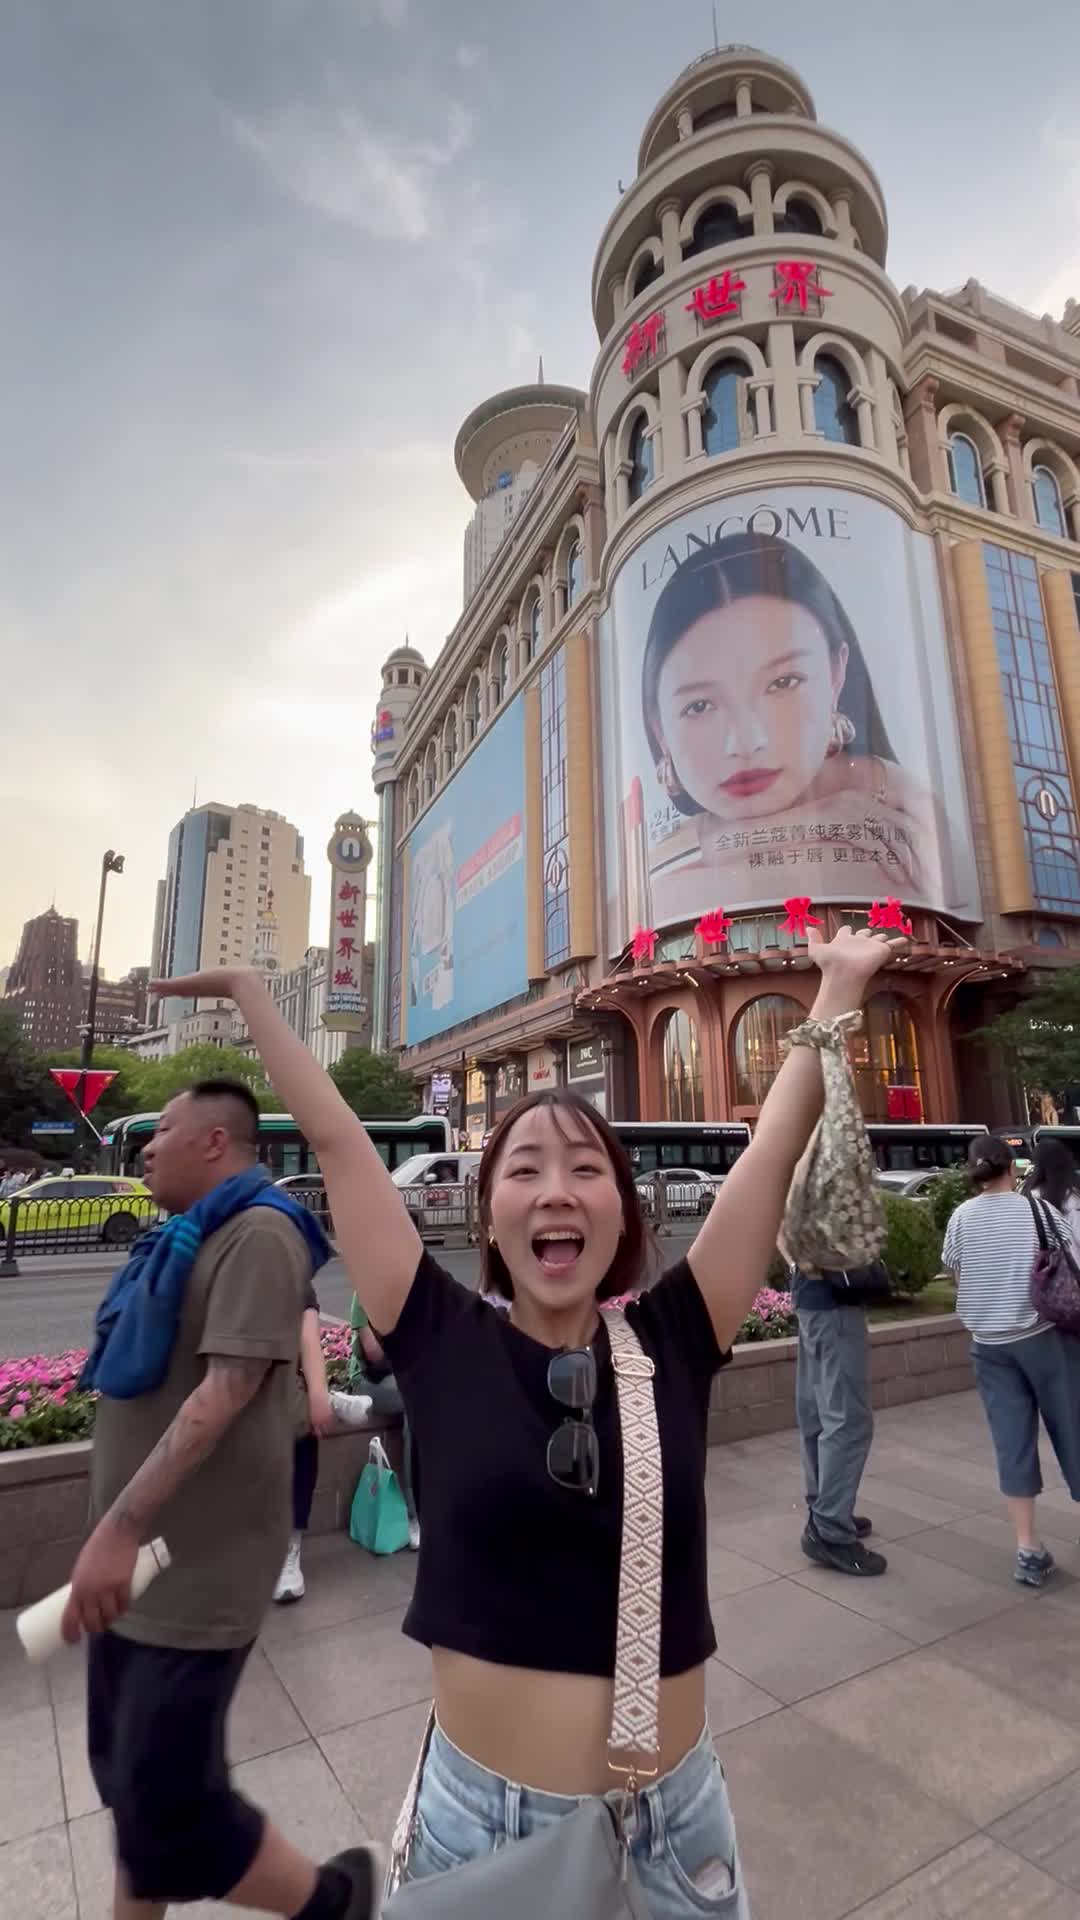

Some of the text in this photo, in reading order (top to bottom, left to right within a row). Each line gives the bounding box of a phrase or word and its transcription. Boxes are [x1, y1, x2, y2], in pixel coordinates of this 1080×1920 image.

[622, 261, 833, 375] 新世界
[642, 503, 852, 590] LANCÔME
[334, 880, 361, 989] 新世界城
[632, 897, 912, 960] 新世界城
